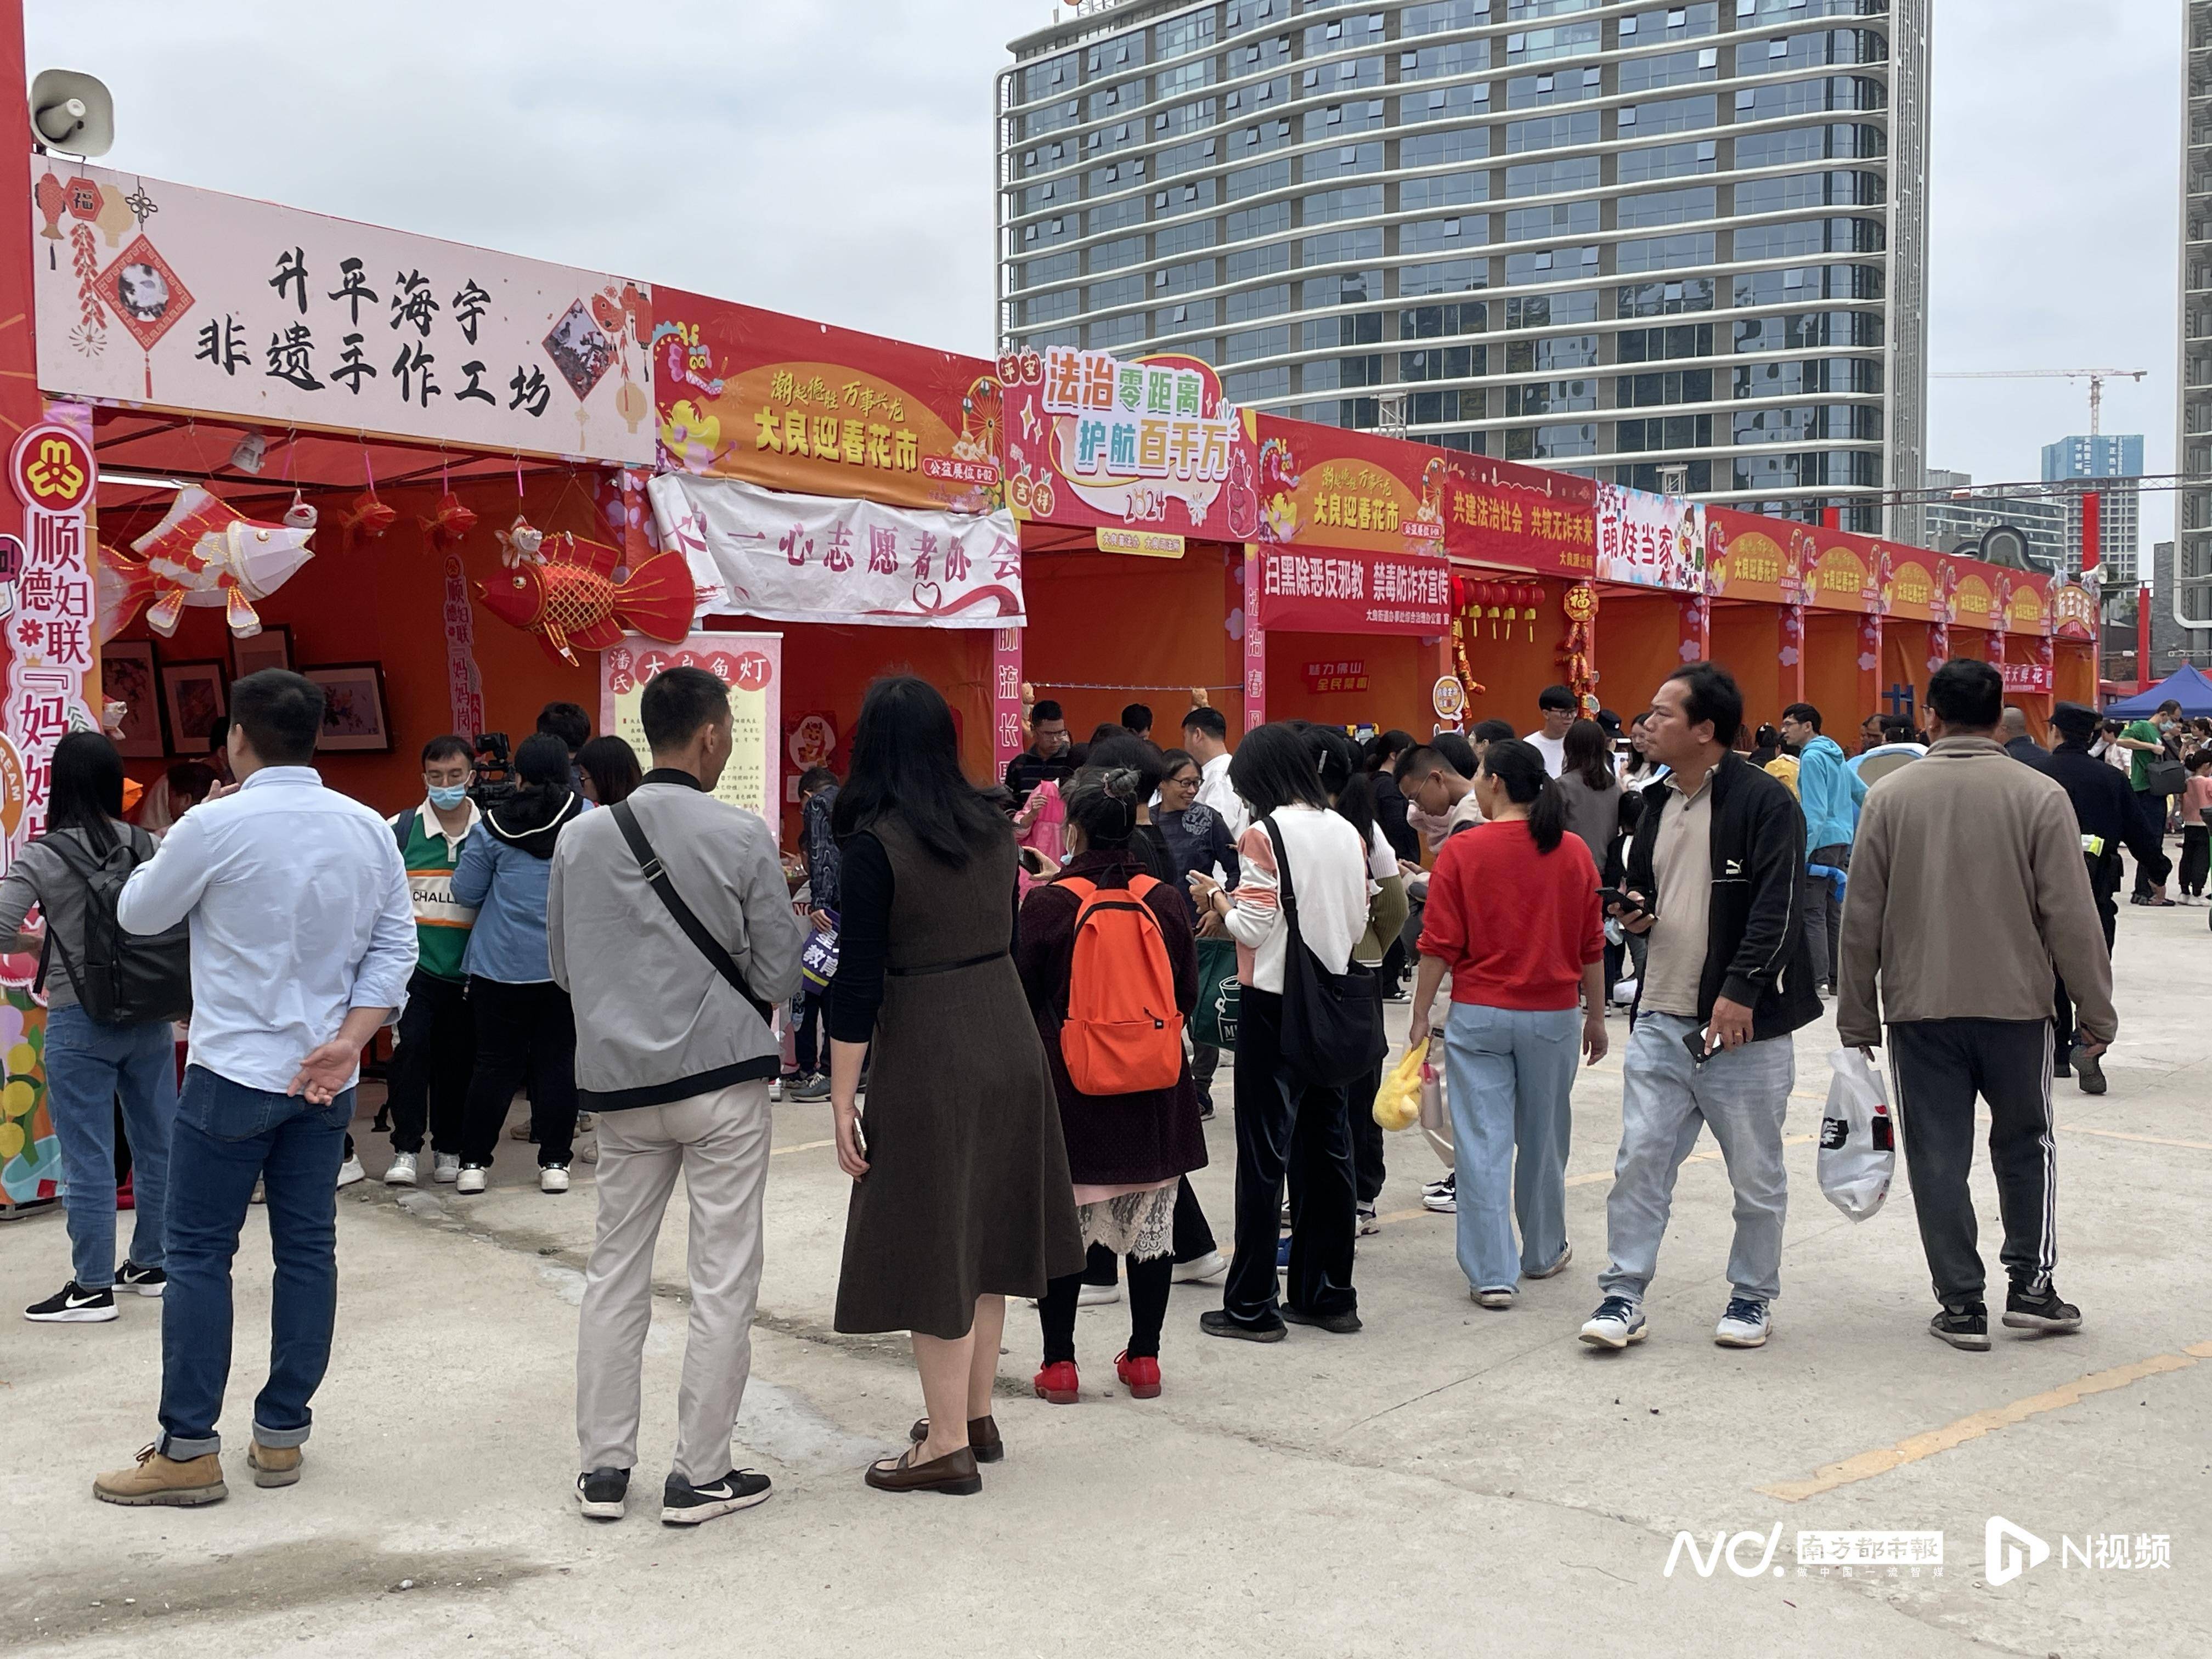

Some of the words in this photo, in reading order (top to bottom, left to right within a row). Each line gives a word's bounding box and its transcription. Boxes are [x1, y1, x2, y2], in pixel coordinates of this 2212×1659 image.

[268, 246, 491, 345] 升平海宇
[195, 314, 551, 418] 非遗手作工坊
[1002, 360, 1036, 381] 平安
[1047, 352, 1201, 415] 法治零距离
[754, 406, 919, 473] 大良迎春花市
[1079, 419, 1229, 472] 护航百千万
[929, 460, 975, 480] 公益展位
[1016, 479, 1050, 512] 吉祥
[1124, 488, 1166, 523] 2024
[1313, 492, 1400, 532] 大良迎春花市
[1453, 490, 1523, 534] 共建法治社会
[1530, 502, 1593, 547] 共筑无诈未来
[692, 501, 1022, 582] 一心志愿者协会
[1559, 550, 1593, 569] 大良派出所
[1602, 515, 1674, 569] 萌娃当家
[20, 511, 88, 664] 顺德妇联
[1265, 553, 1364, 600] 扫黑除恶反邪教
[1373, 561, 1449, 606] 禁毒防诈齐宣传
[1570, 587, 1591, 610] 福
[610, 651, 632, 692] 潘氏
[413, 891, 460, 904] CHALL
